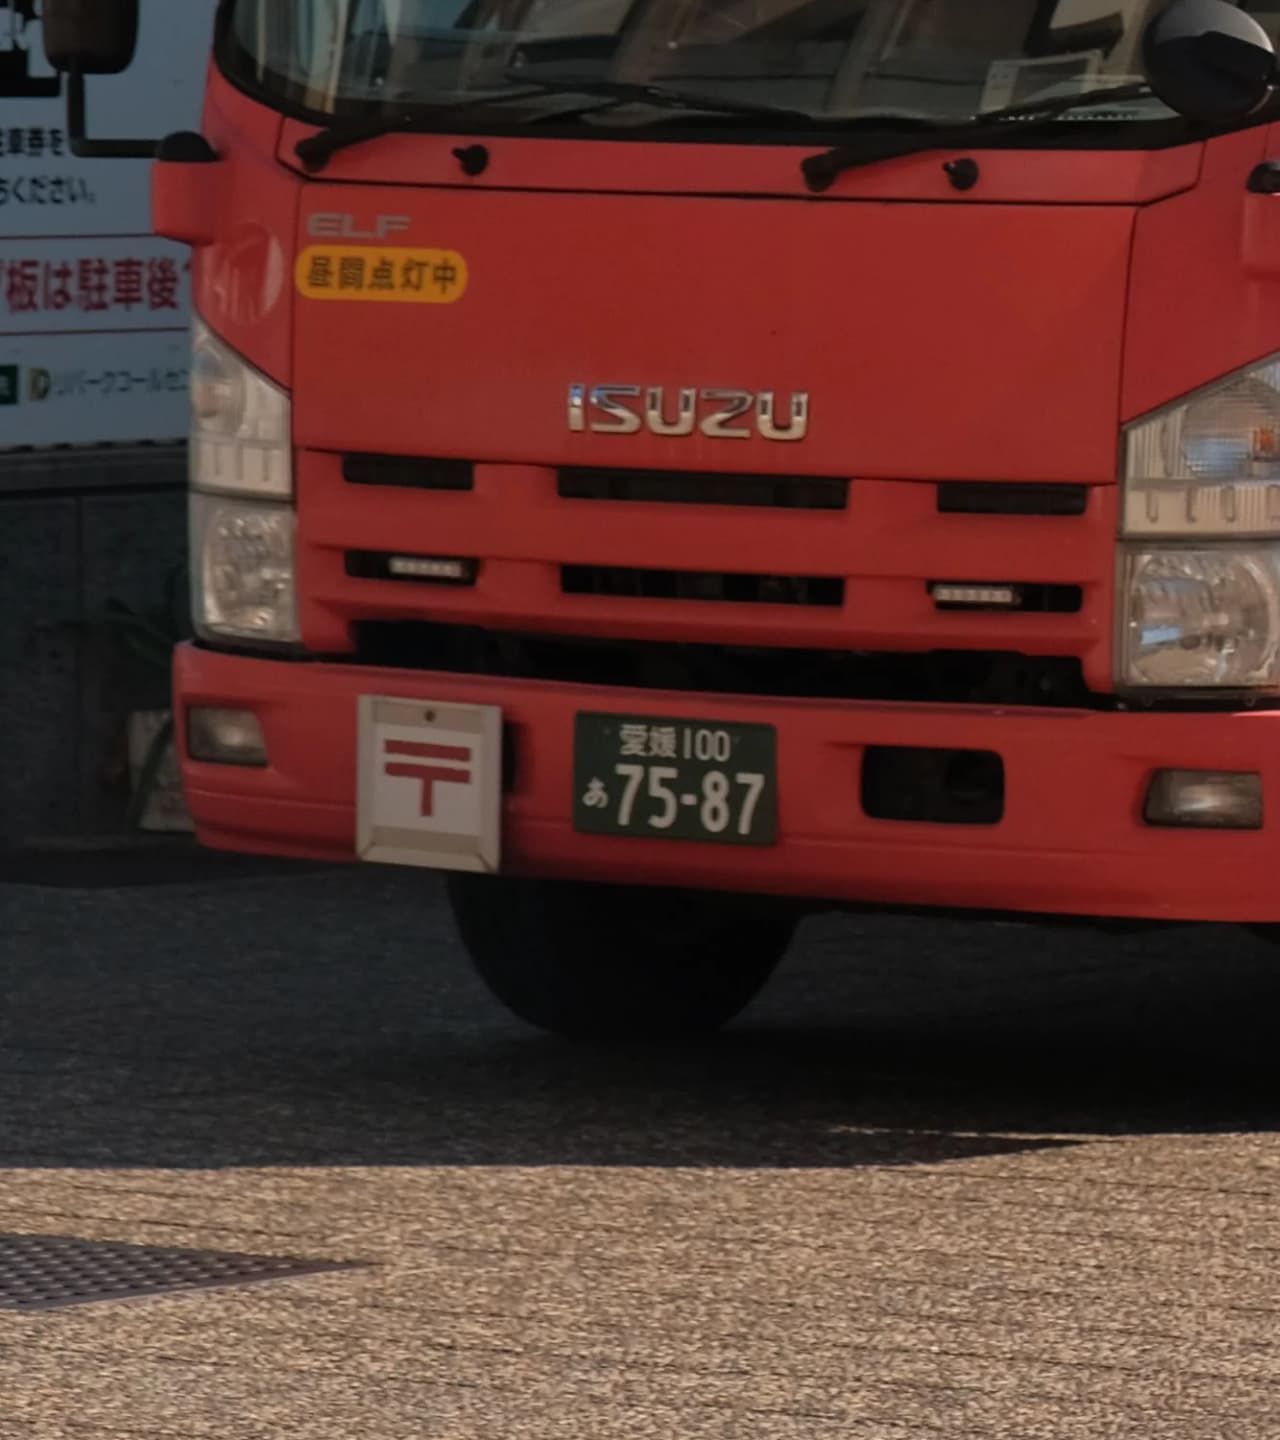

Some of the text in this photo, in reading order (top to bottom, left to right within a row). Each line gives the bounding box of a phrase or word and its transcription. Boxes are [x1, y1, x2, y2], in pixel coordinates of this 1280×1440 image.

[306, 212, 411, 239] ELF
[0, 257, 192, 312] 板は駐車後
[567, 381, 811, 441] ISUZU
[615, 763, 766, 836] 75-87
